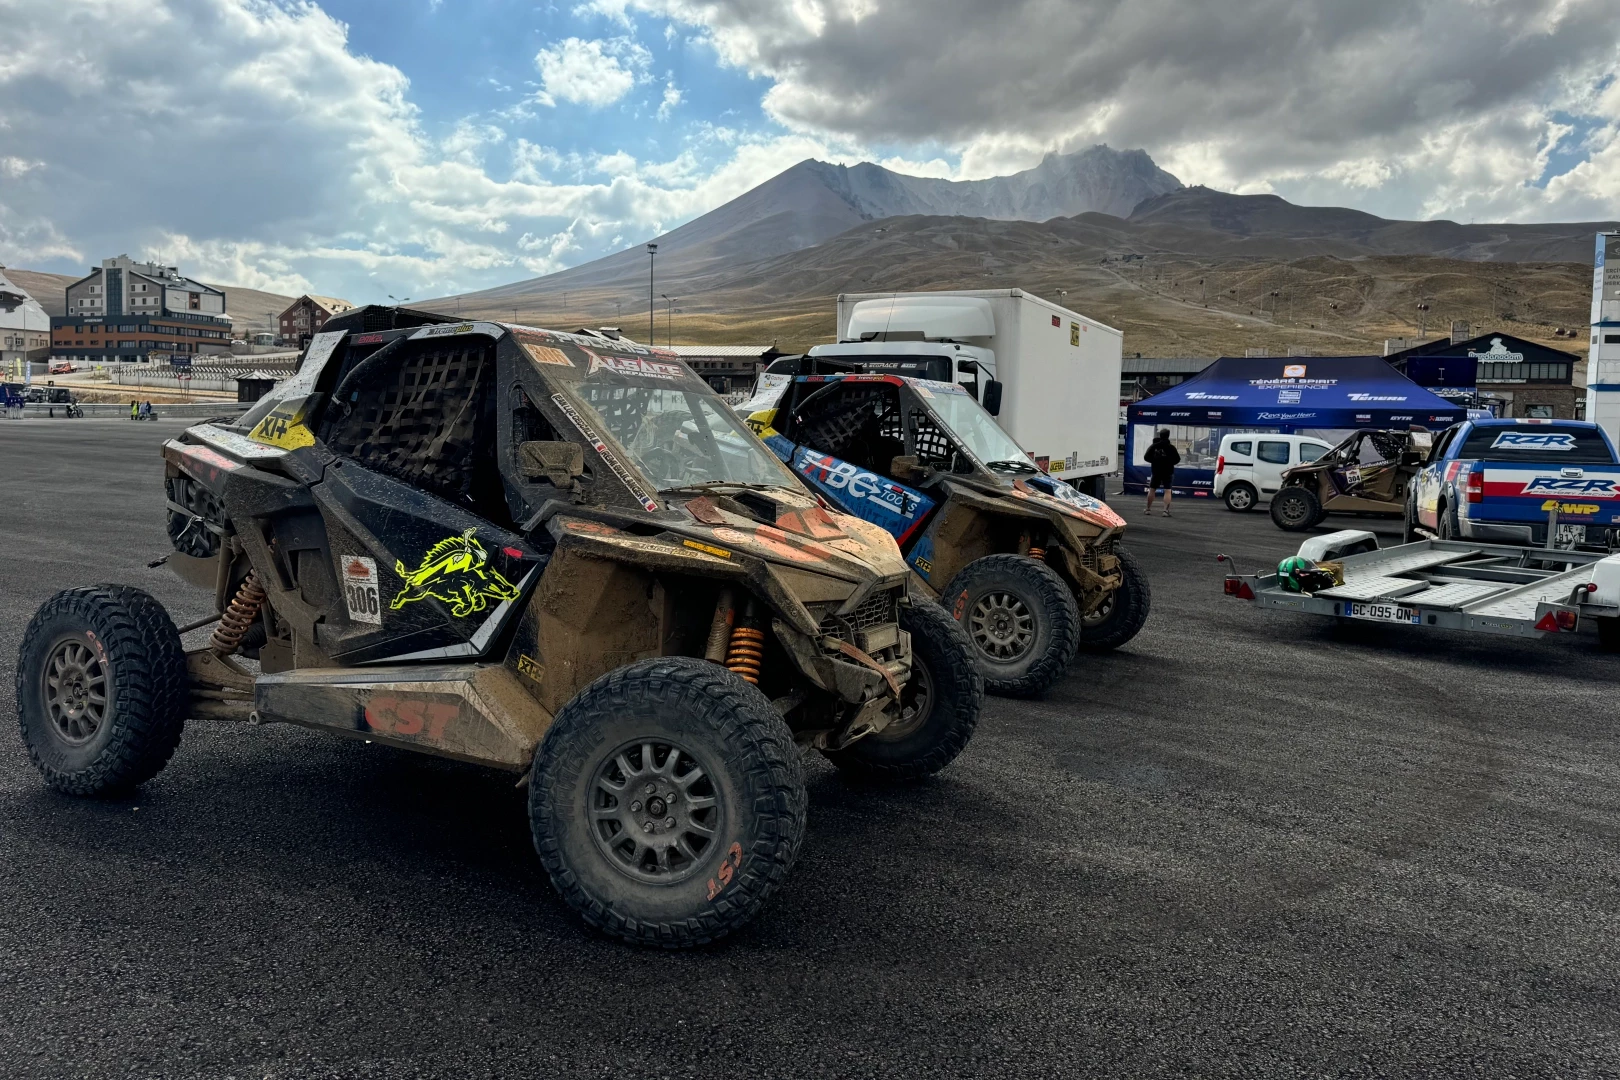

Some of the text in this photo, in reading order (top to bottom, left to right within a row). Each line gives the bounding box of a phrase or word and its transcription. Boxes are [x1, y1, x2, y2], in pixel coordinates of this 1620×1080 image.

[555, 332, 650, 355] POLARIS
[1495, 434, 1571, 446] RZR
[1526, 478, 1617, 493] RZR
[880, 489, 918, 512] TOOS
[346, 585, 379, 616] 306
[1352, 603, 1411, 620] GC-095-QN
[364, 697, 460, 738] CST
[706, 841, 743, 901] CST
